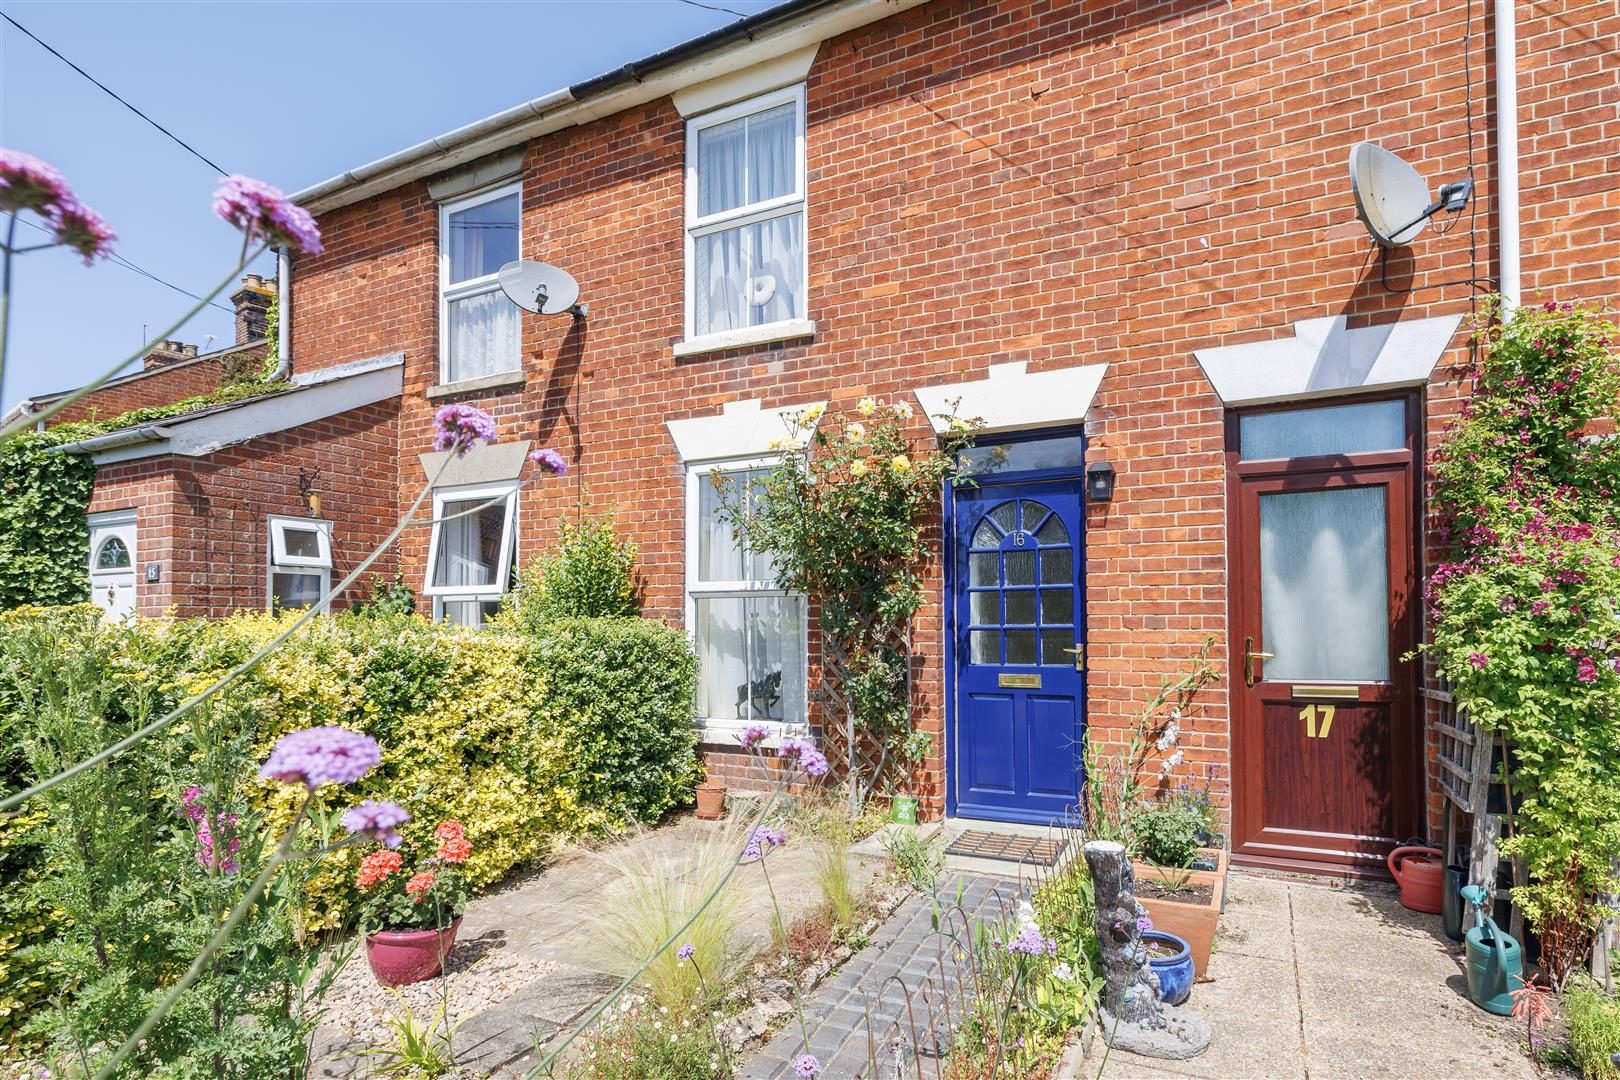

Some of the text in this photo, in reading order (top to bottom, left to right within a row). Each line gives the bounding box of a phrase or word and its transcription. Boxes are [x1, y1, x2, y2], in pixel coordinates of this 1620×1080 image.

[1013, 532, 1025, 546] 16
[148, 567, 156, 578] 15
[1299, 704, 1335, 738] 17
